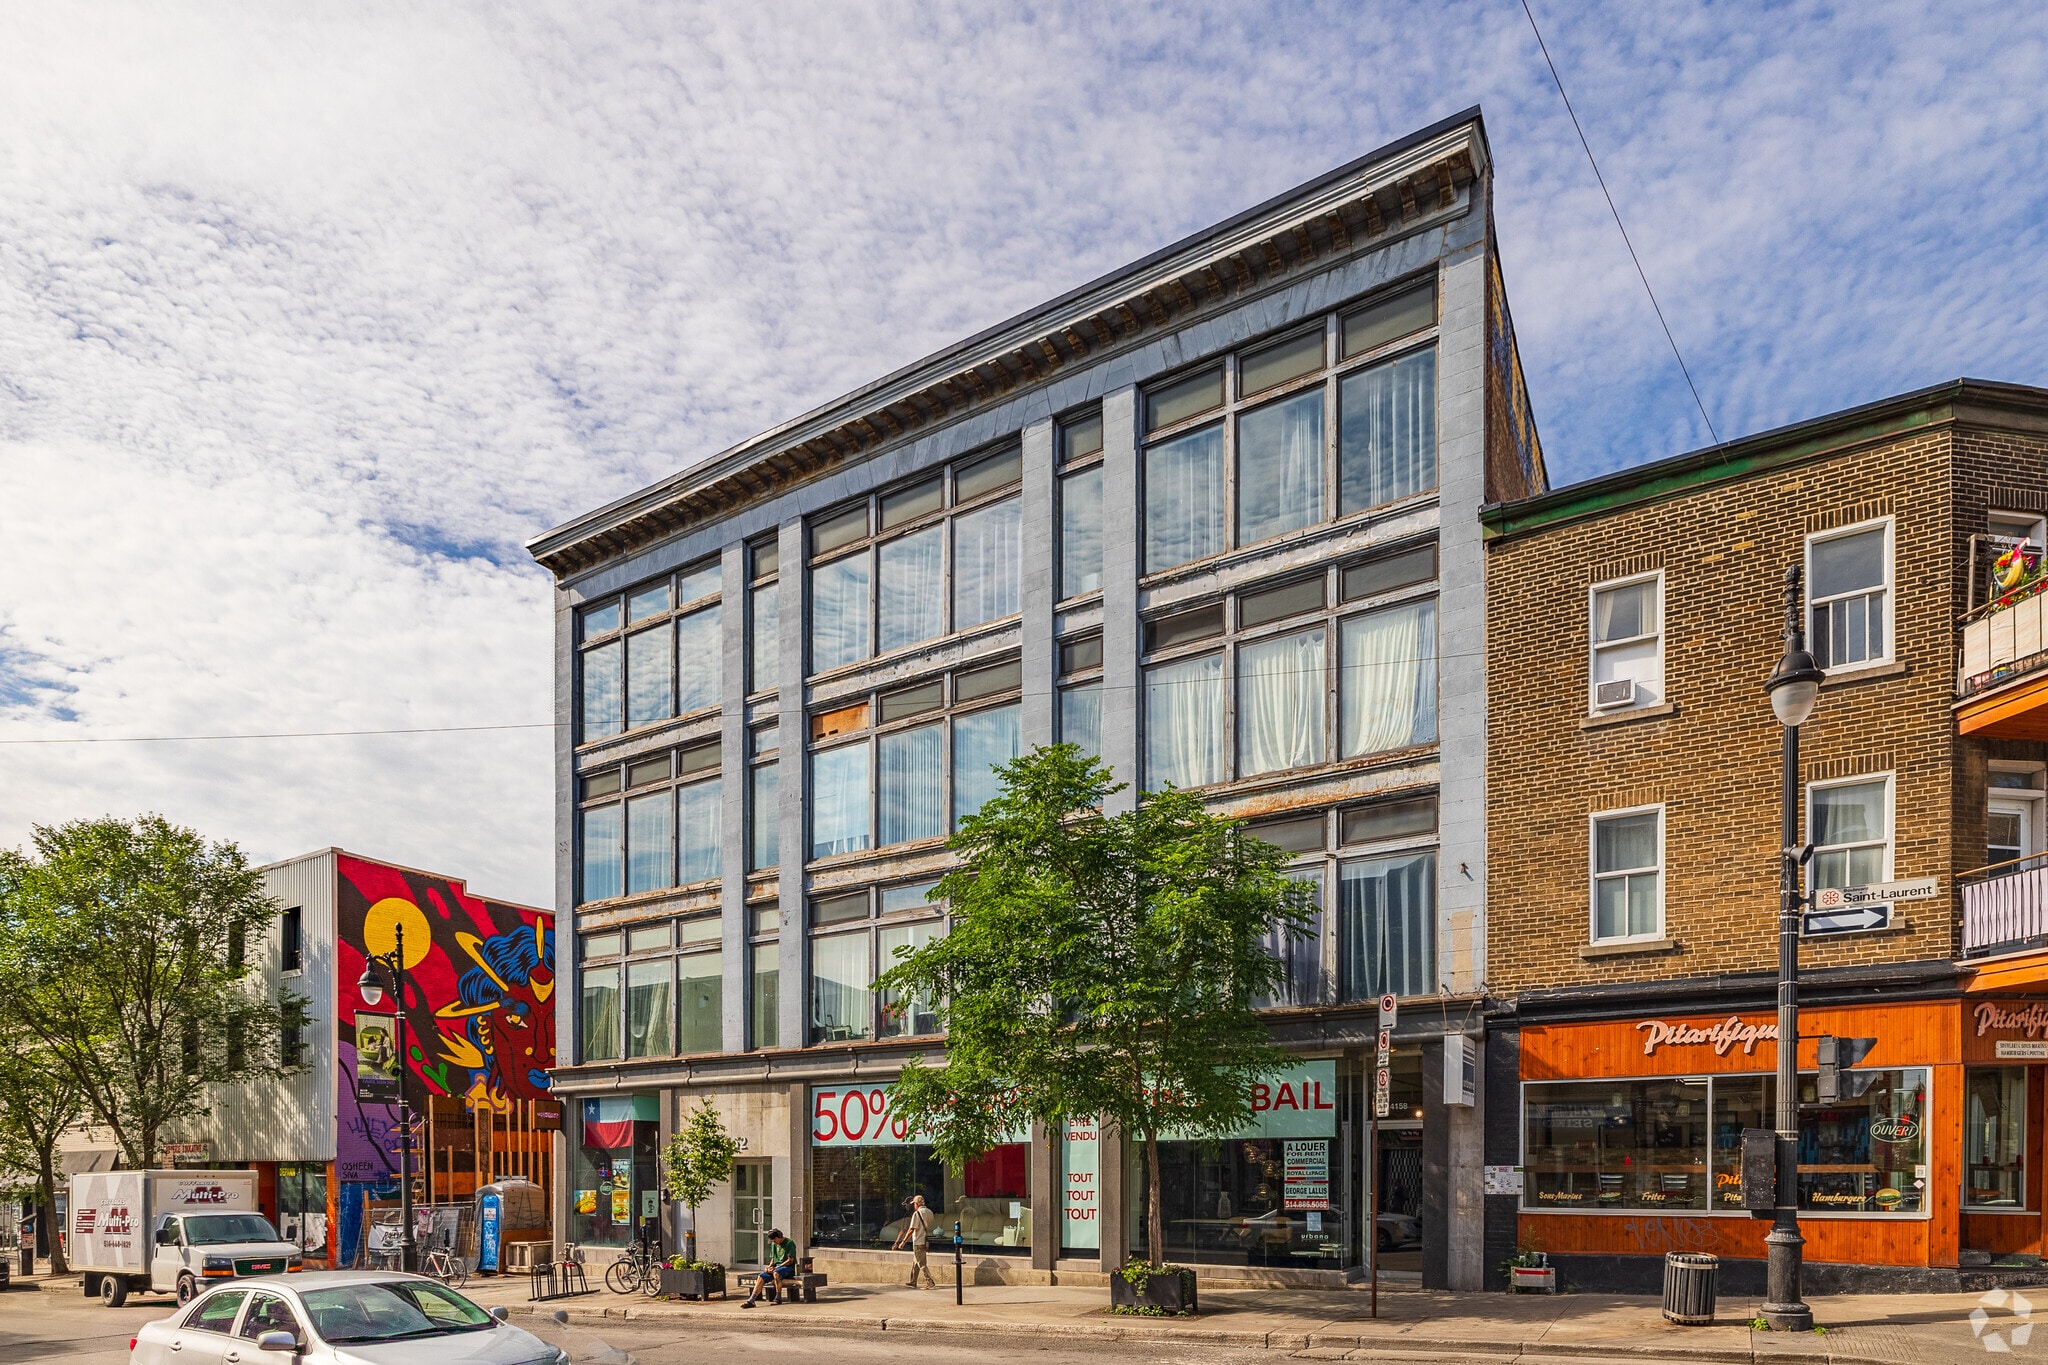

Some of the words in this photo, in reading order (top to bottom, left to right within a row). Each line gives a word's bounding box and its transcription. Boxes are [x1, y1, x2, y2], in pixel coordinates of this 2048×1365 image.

[1843, 885, 1933, 903] Saint-Laurent
[1636, 1016, 1778, 1055] Pitarifiqu
[1251, 1082, 1333, 1112] BAIL
[812, 1088, 908, 1142] 50%
[1873, 1125, 1916, 1136] OUVERT
[1064, 1131, 1097, 1142] VENDU
[1287, 1143, 1294, 1152] A
[1295, 1143, 1326, 1152] LOUER
[342, 1162, 373, 1170] OSHEEN
[1067, 1173, 1093, 1183] TOUT
[171, 1189, 239, 1200] Multi-Pro
[1066, 1190, 1095, 1201] TOUT
[1285, 1187, 1307, 1195] GEORGE
[1538, 1191, 1583, 1201] Sous-Marins
[1641, 1191, 1666, 1201] Frites
[1812, 1192, 1867, 1204] Hamburgers
[1065, 1208, 1097, 1220] TOUT
[97, 1212, 139, 1228] Multi-Pro
